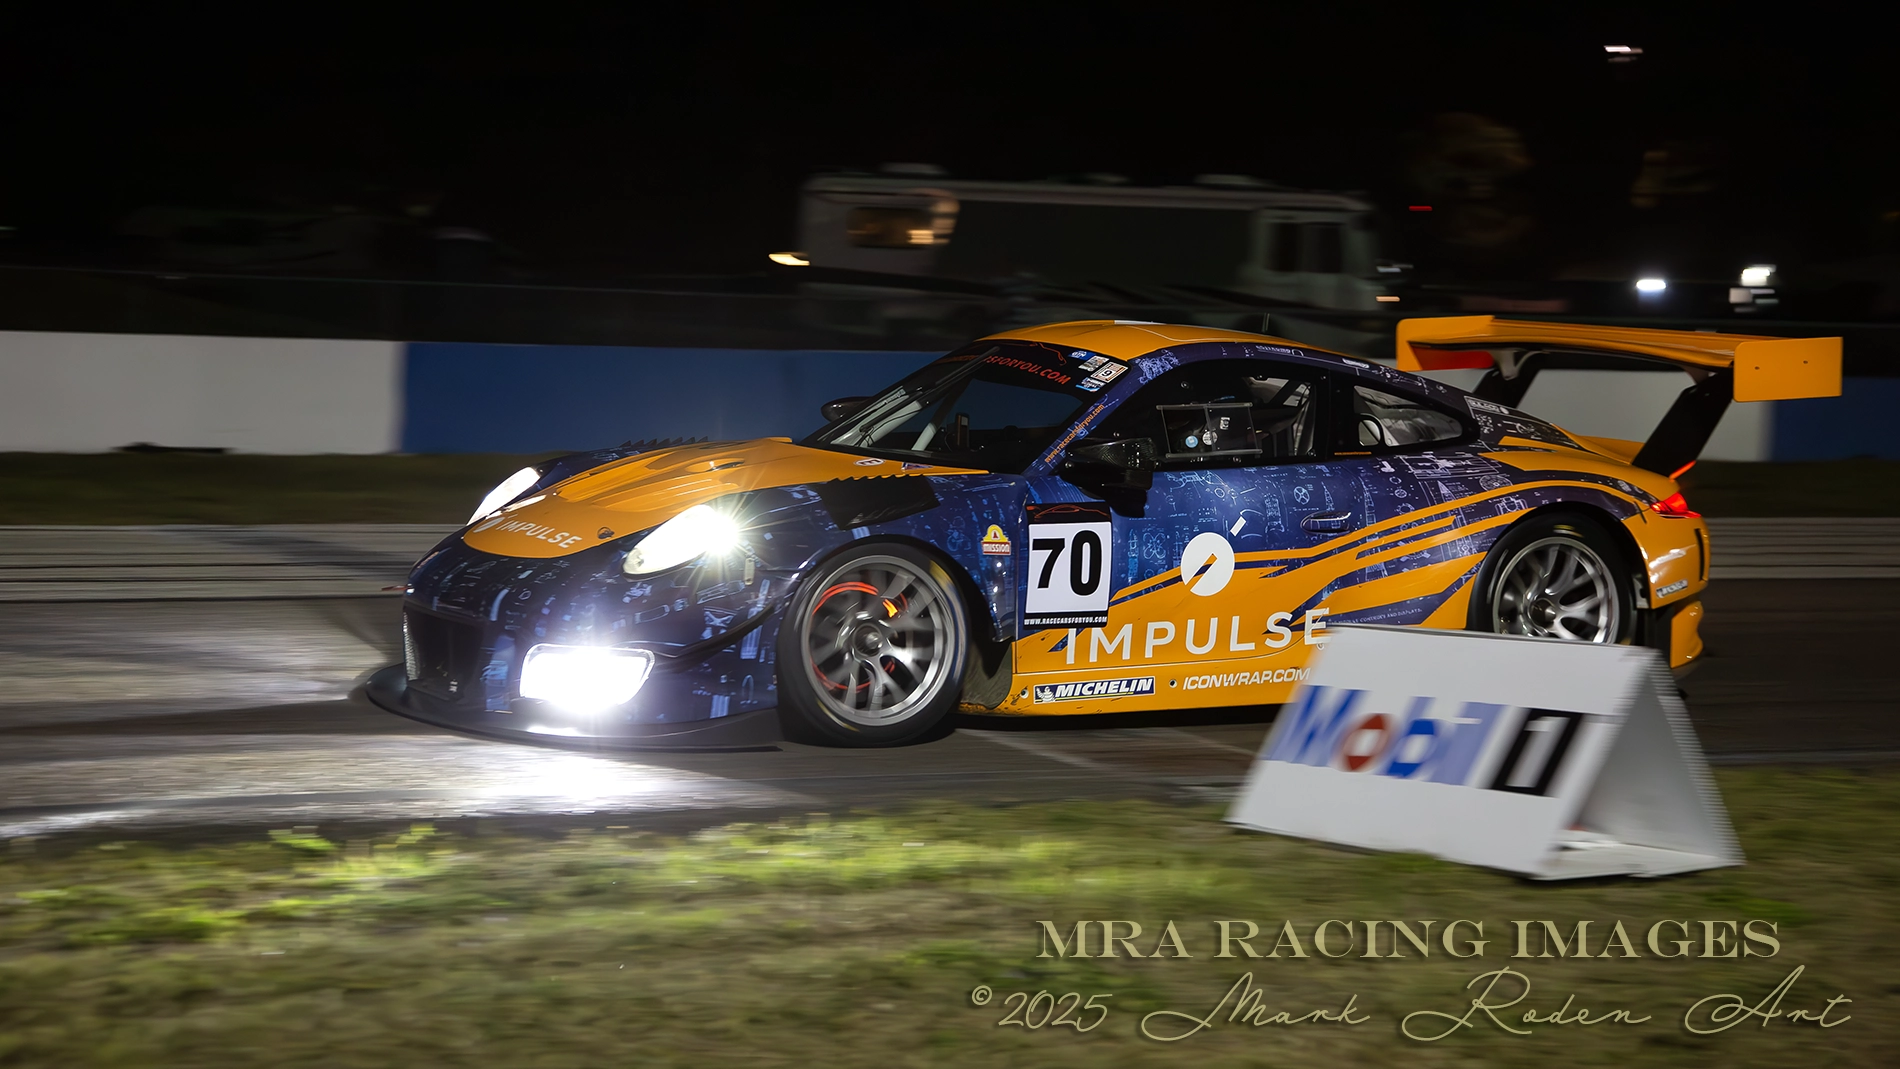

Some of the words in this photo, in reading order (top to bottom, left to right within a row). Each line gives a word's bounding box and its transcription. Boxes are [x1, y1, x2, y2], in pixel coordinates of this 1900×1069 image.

[495, 520, 583, 548] IMPULSE
[1032, 530, 1103, 596] 70
[1024, 616, 1107, 625] WWW.RACECARSFORYOU.COM
[1066, 607, 1331, 664] IMPULSE
[1054, 678, 1153, 698] MICHELIN
[1182, 668, 1310, 690] ICONWRAP.COM
[1262, 685, 1511, 786] Mobil
[1496, 710, 1576, 794] 1
